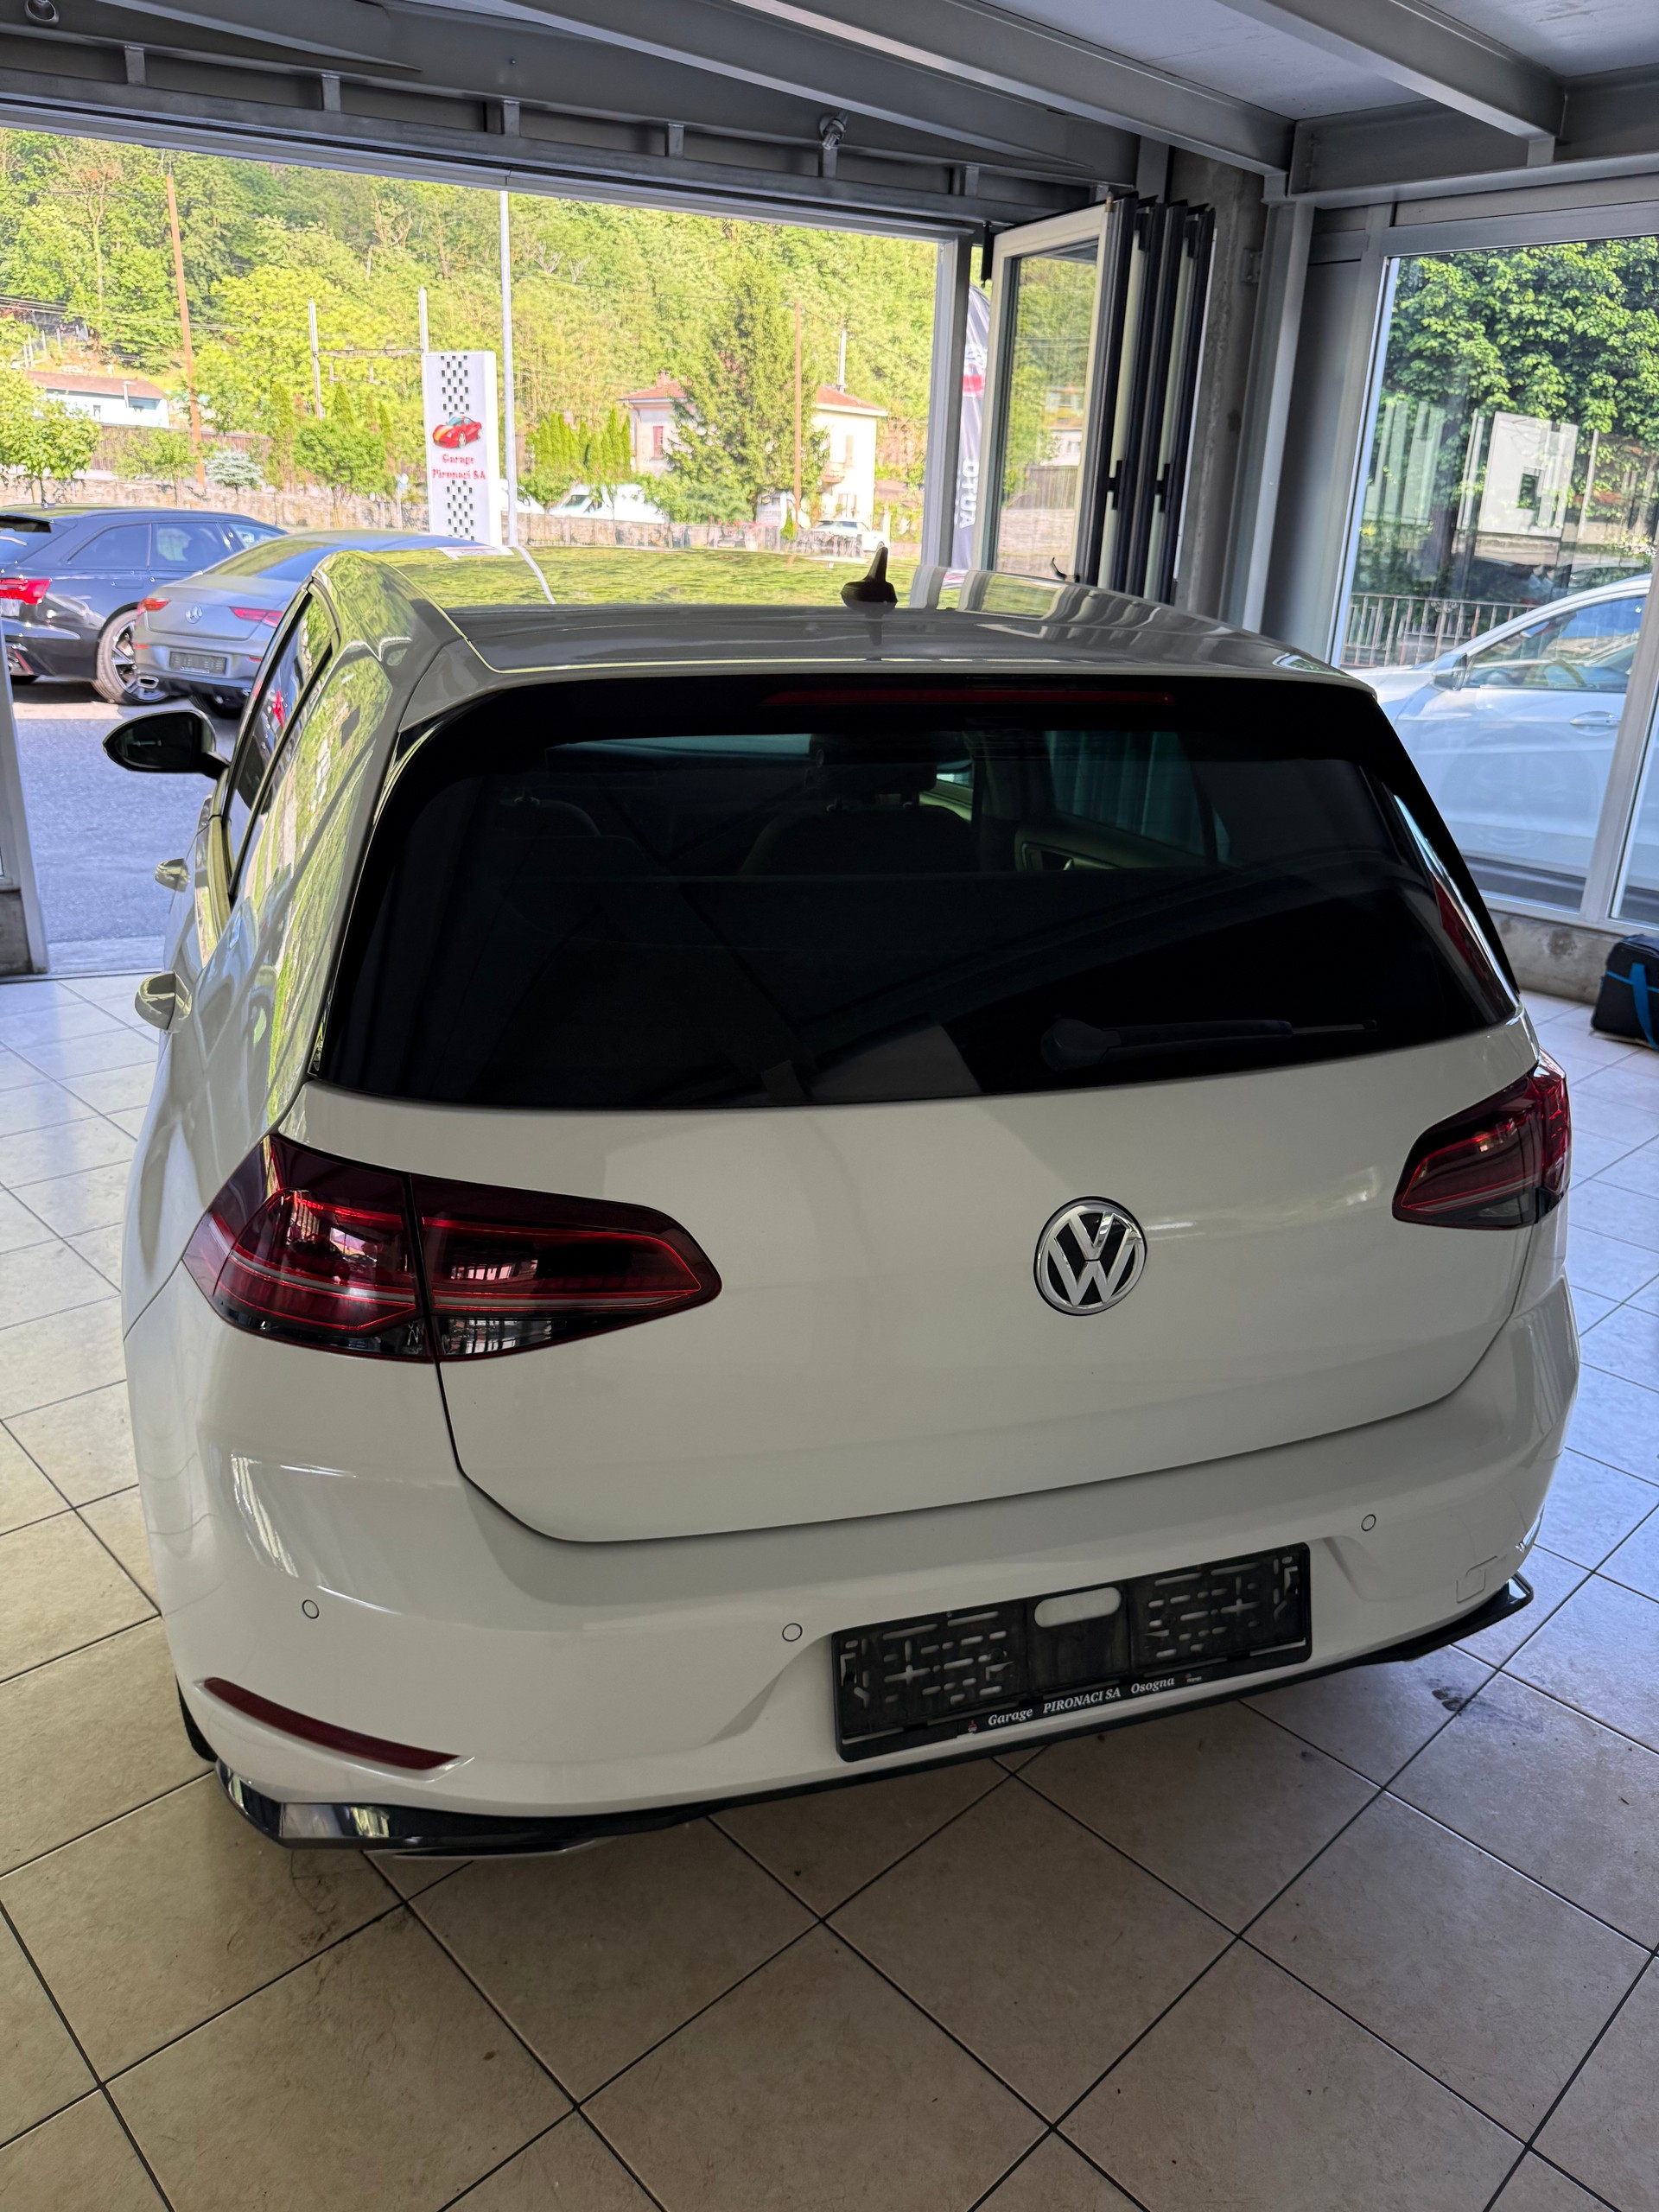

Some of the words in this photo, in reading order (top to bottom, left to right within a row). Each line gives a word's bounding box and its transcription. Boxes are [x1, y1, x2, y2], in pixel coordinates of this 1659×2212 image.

[442, 454, 474, 466] Garage
[473, 470, 486, 480] SA
[1044, 1206, 1138, 1306] VW
[988, 1708, 1033, 1726] Garage
[1042, 1692, 1103, 1714] PIRONACI
[1105, 1687, 1122, 1700] SA
[1130, 1677, 1175, 1694] Osogna
